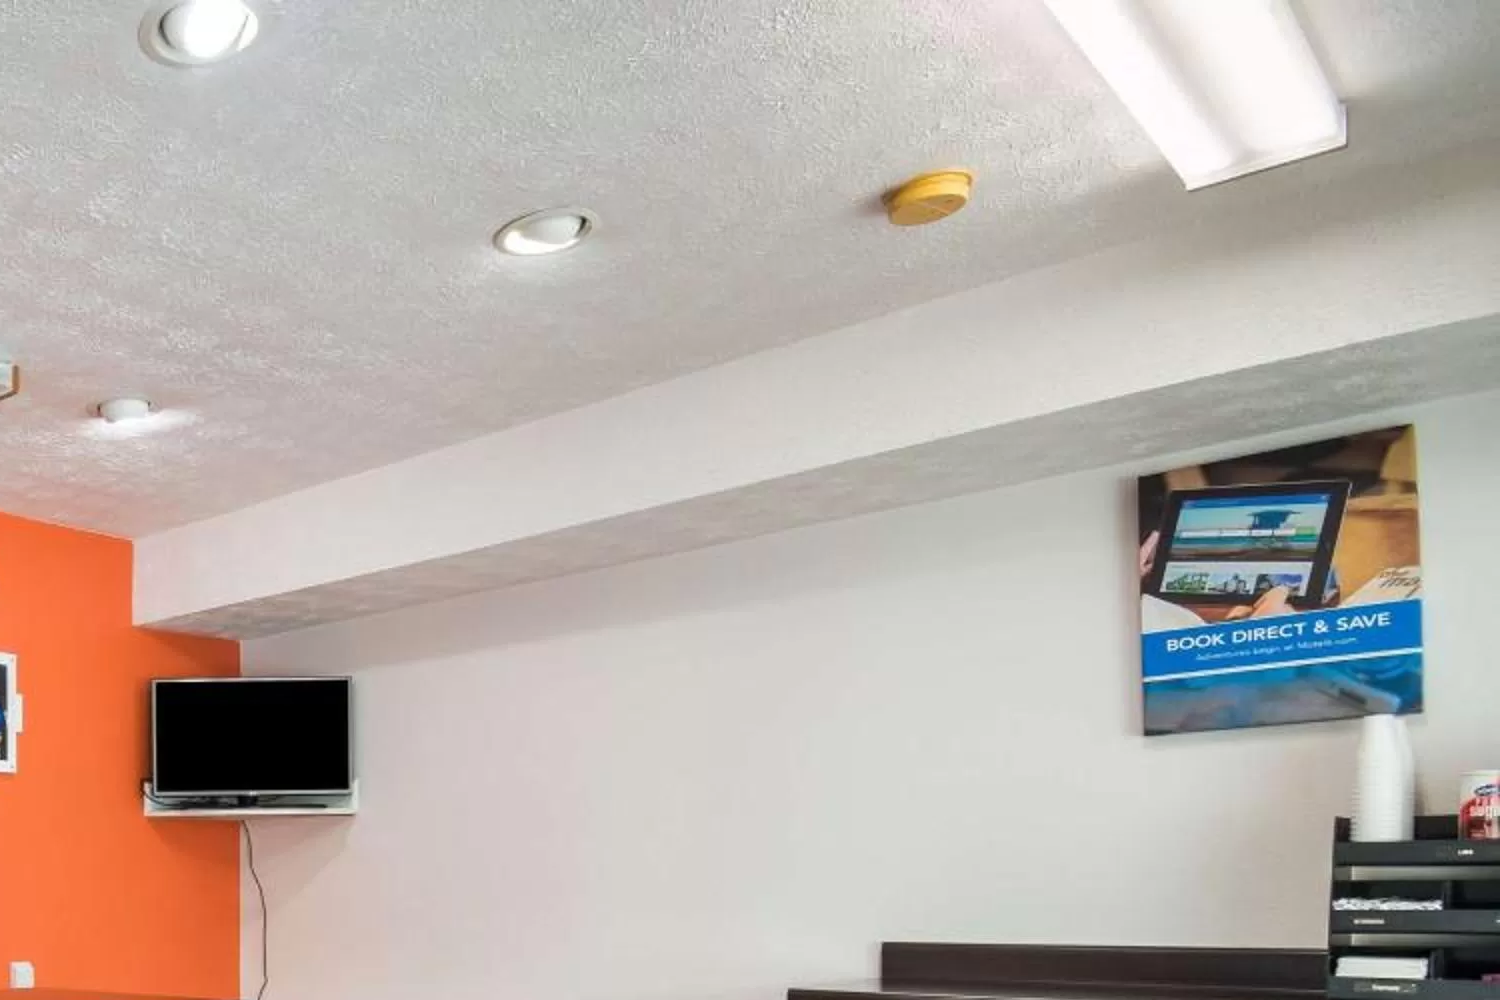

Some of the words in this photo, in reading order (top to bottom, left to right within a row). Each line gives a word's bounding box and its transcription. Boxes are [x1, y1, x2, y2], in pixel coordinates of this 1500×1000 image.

[1166, 633, 1225, 652] BOOK
[1232, 620, 1307, 644] DIRECT
[1313, 618, 1329, 635] &
[1336, 611, 1391, 632] SAVE
